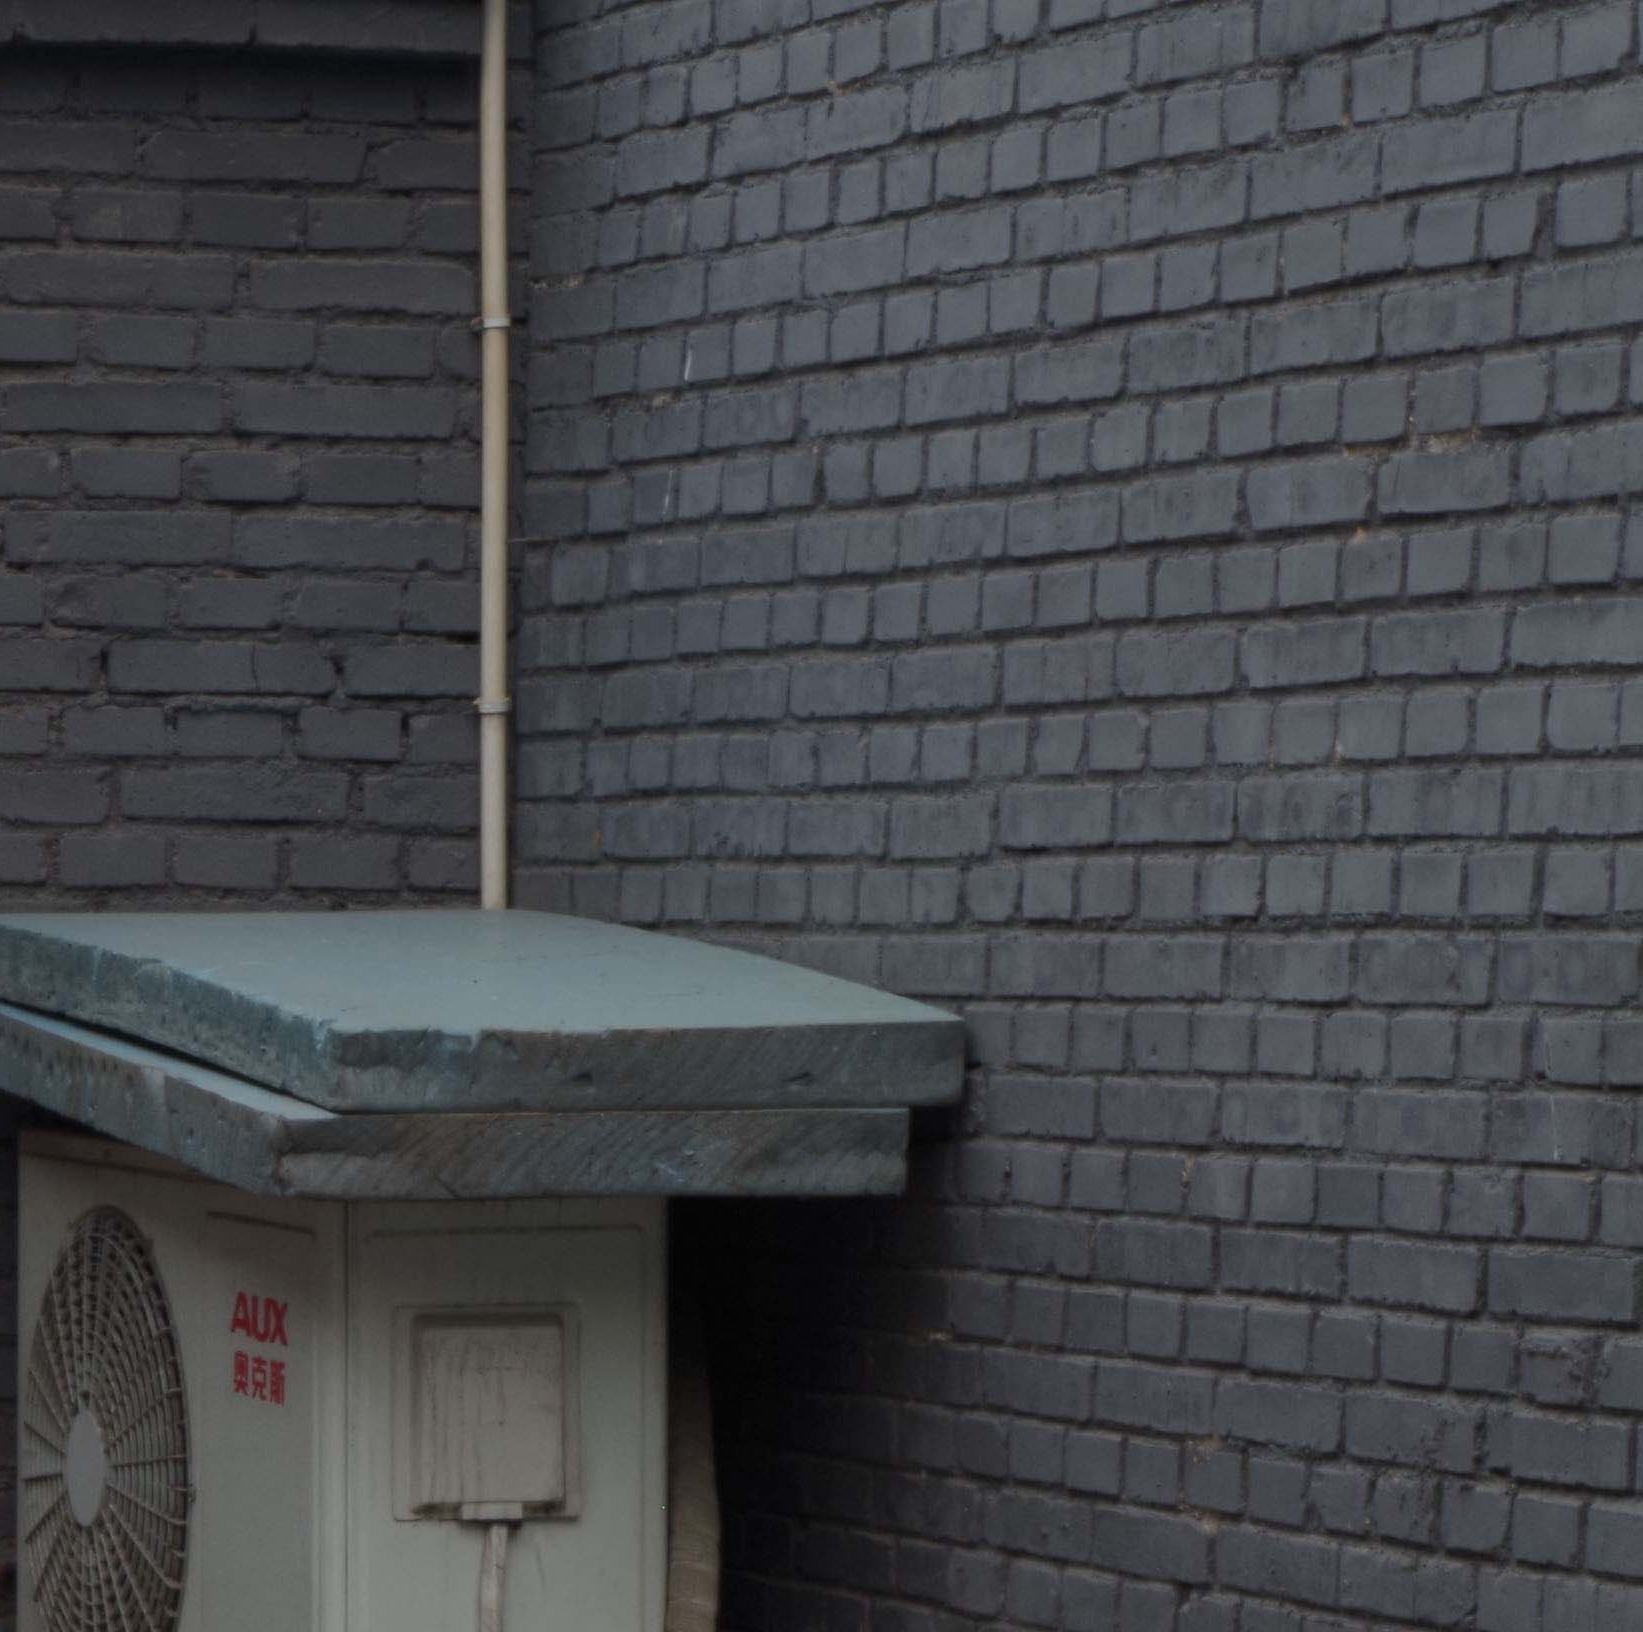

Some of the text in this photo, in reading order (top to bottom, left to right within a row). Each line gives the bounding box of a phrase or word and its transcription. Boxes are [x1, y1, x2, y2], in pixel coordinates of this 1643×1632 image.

[231, 1291, 288, 1345] AUX
[233, 1350, 286, 1407] 奥克斯
